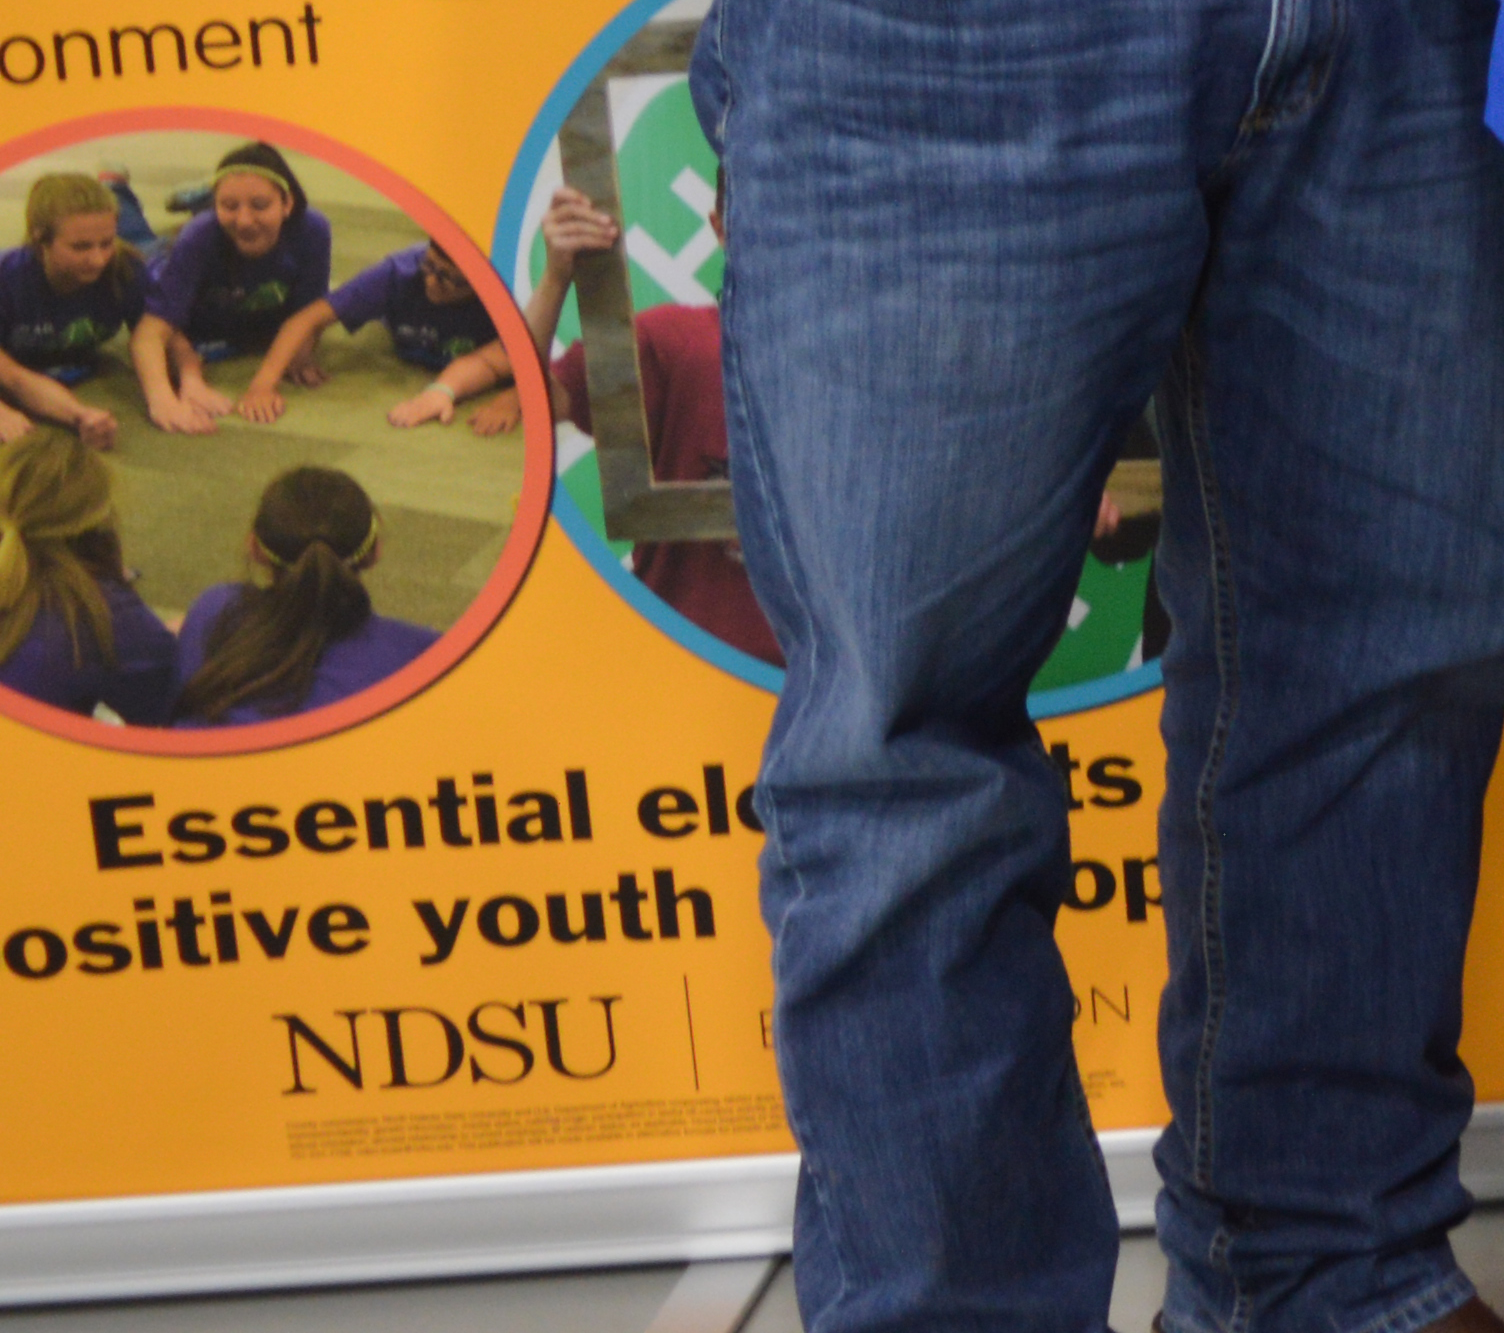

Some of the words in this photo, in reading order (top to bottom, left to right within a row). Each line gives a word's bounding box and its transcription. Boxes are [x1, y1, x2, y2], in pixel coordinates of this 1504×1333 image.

[89, 767, 594, 871] Essential
[416, 868, 717, 968] youth
[272, 995, 623, 1099] NDSU
